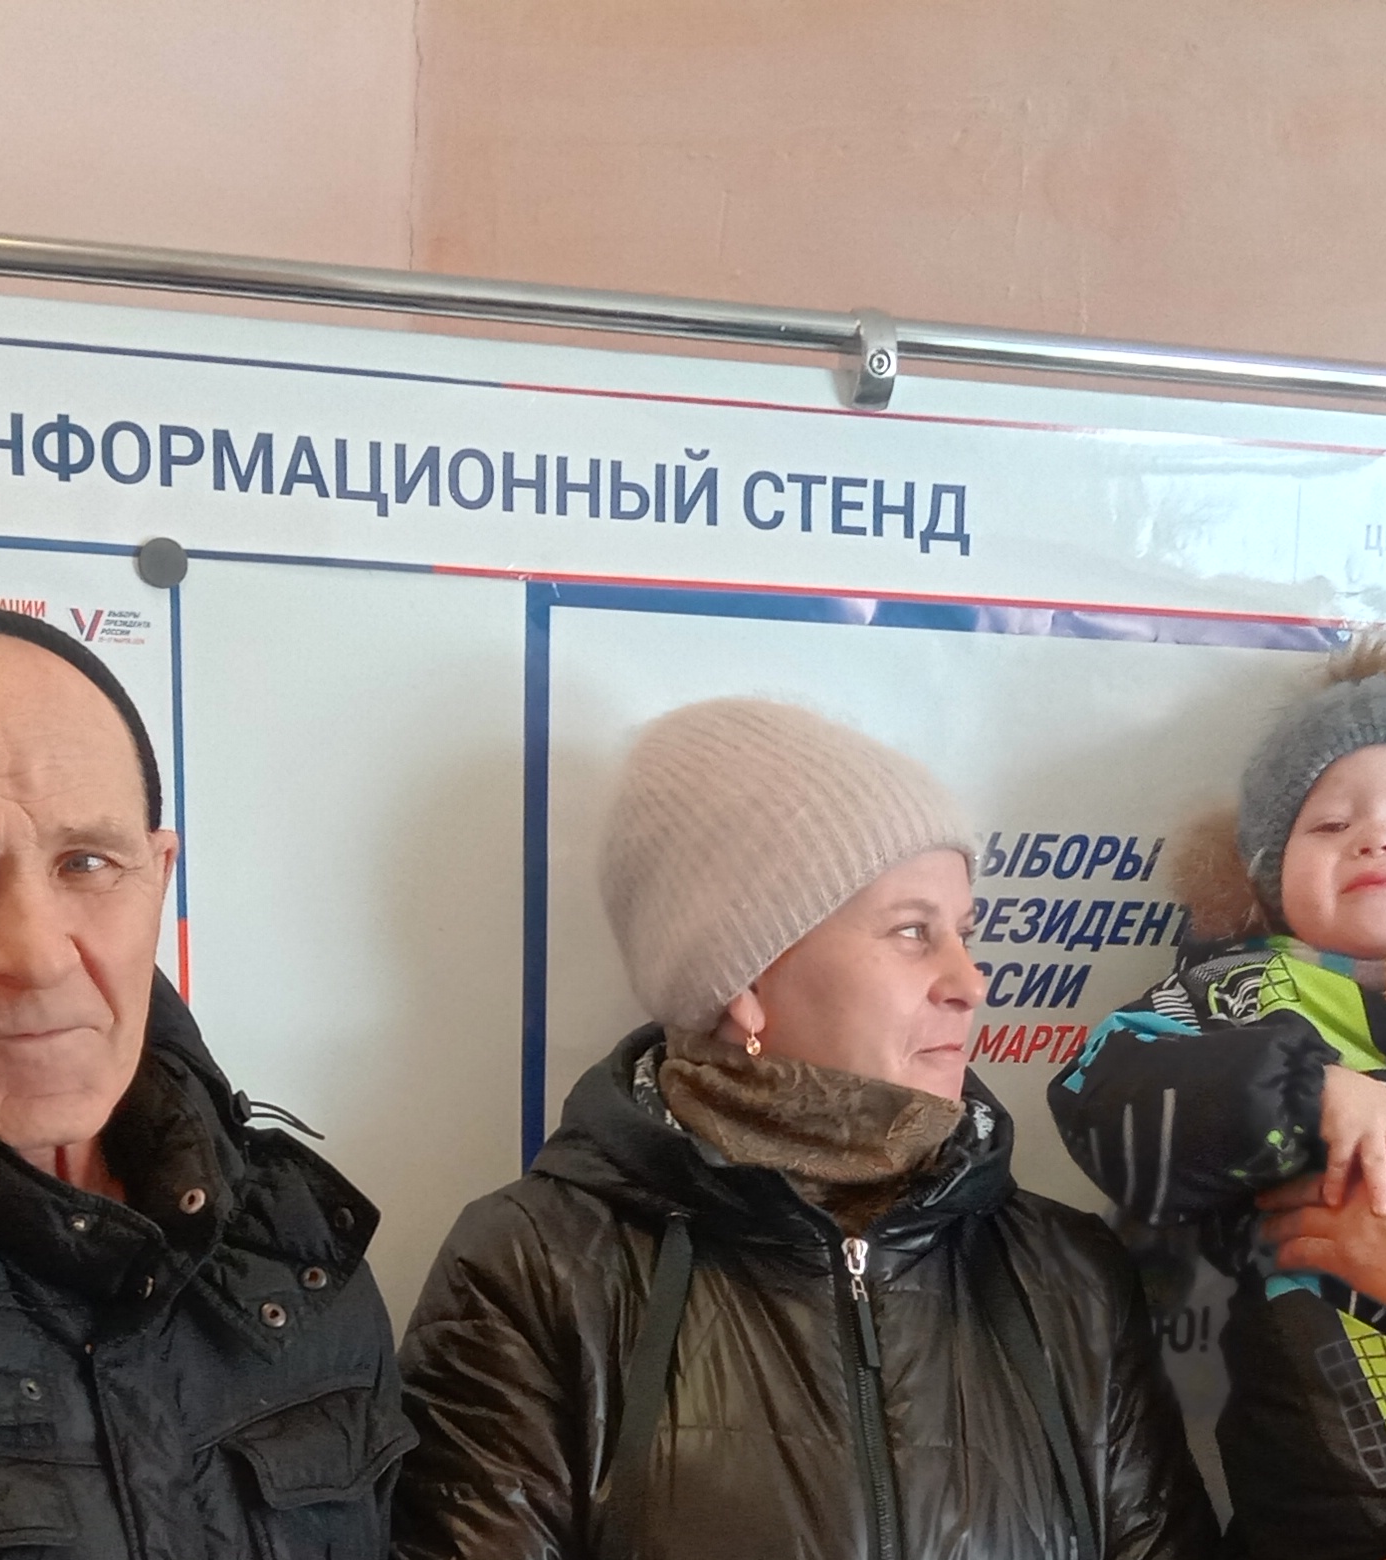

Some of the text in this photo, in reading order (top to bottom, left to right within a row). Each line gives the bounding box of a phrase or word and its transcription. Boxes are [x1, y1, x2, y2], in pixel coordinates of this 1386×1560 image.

[743, 470, 971, 557] СТЕНД
[976, 831, 1165, 882] ЫБОРЫ
[973, 897, 1192, 952] РЕЗИДЕНТ
